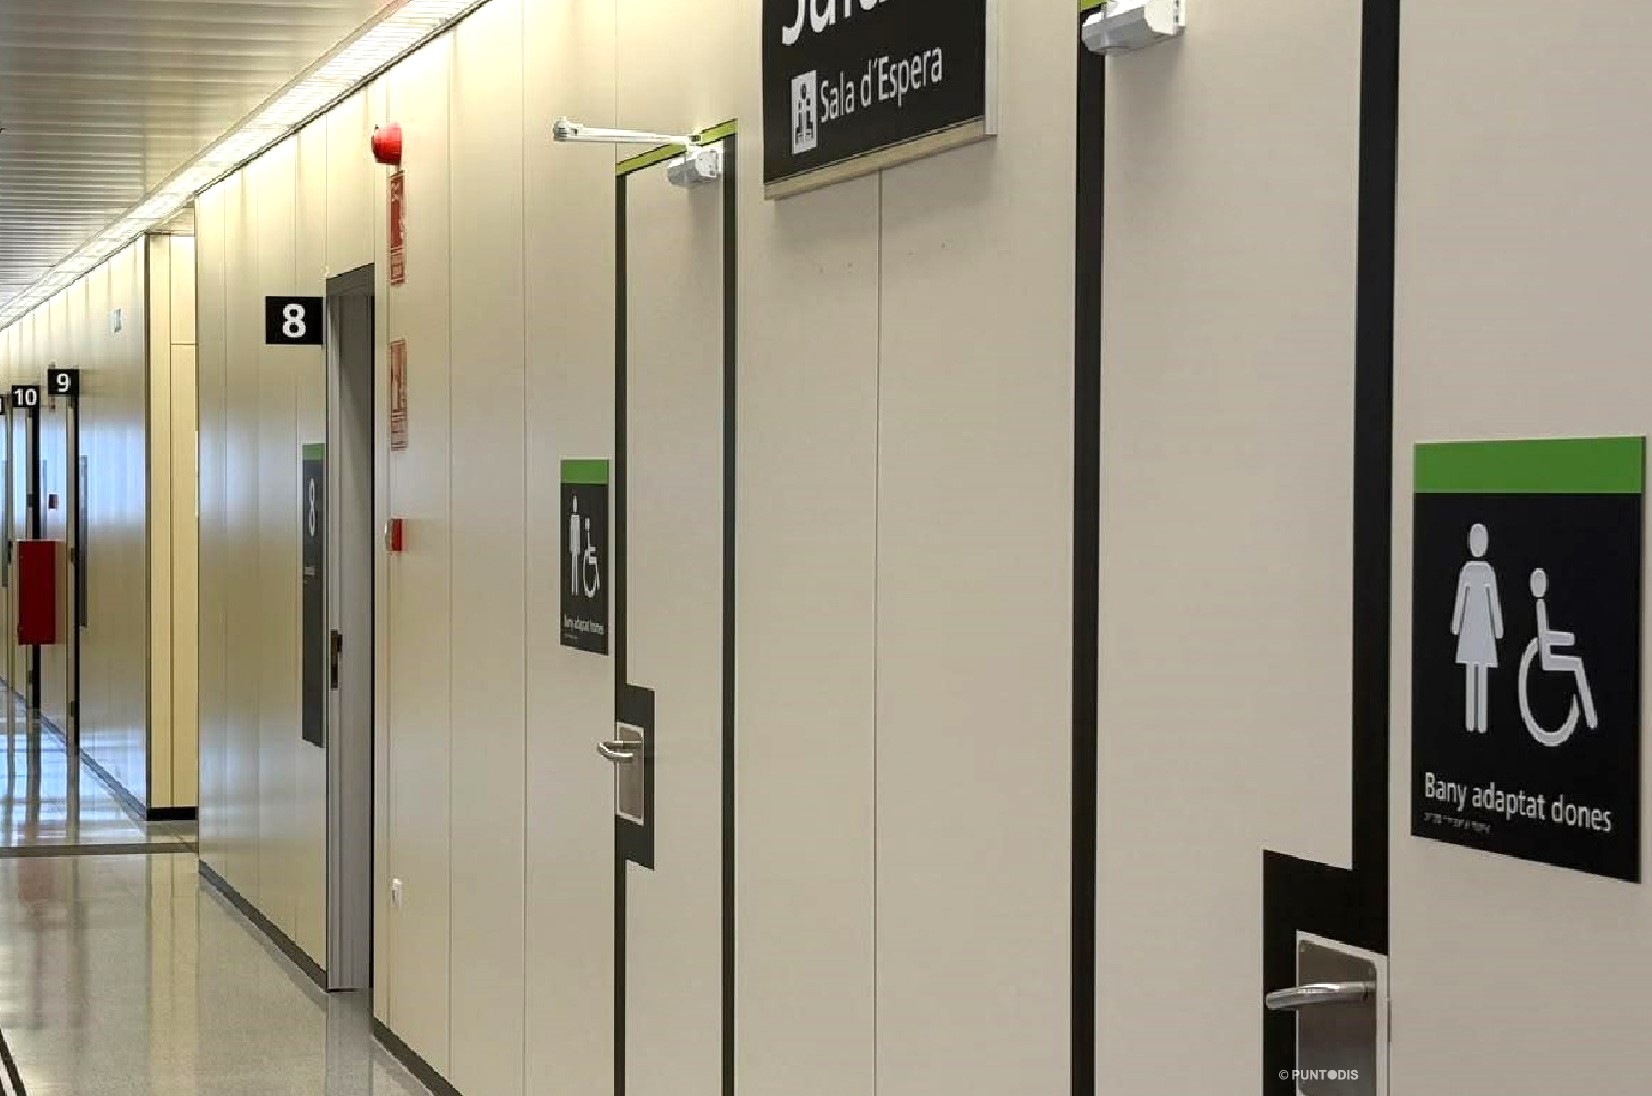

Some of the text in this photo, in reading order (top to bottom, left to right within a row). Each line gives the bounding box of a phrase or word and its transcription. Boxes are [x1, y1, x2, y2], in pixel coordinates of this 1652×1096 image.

[820, 71, 855, 123] Sala
[282, 303, 306, 338] 8
[13, 388, 37, 406] 10
[56, 373, 71, 393] 9
[1425, 771, 1612, 832] Bany adaptat dones
